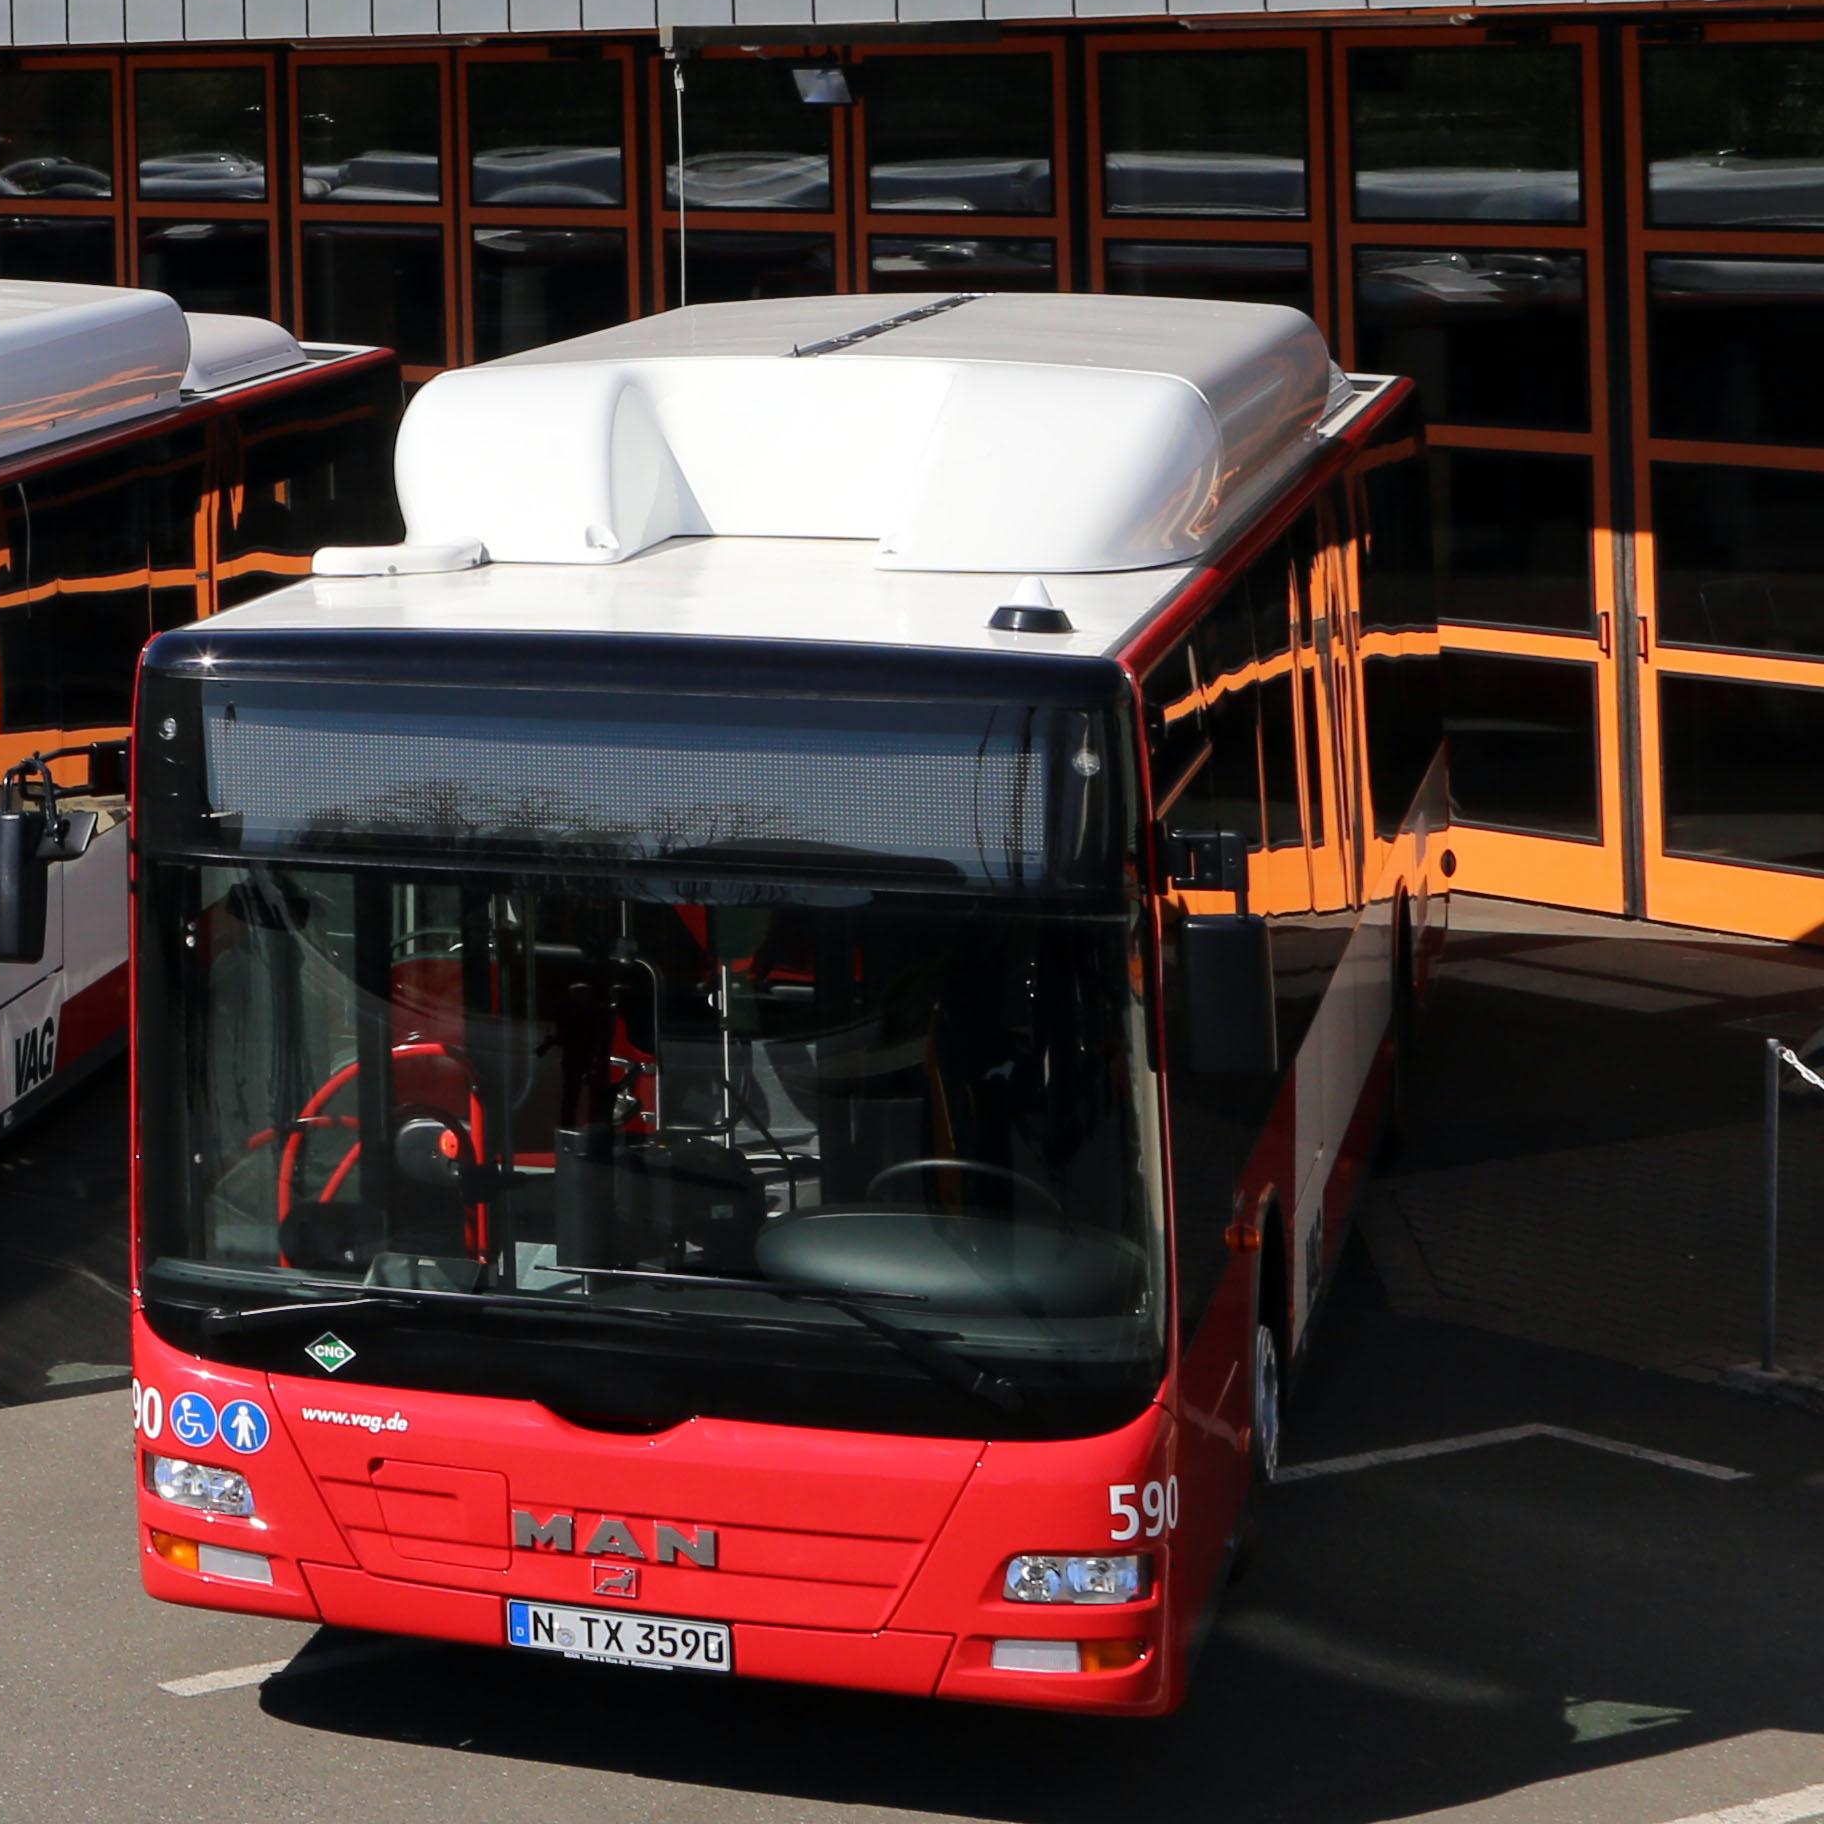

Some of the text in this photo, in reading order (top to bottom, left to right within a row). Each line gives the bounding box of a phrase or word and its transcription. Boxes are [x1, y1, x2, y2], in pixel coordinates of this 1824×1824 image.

[14, 1015, 55, 1099] VAG
[313, 1343, 346, 1359] CNG
[301, 1406, 409, 1433] www.vag.de
[1108, 1474, 1179, 1542] 590
[512, 1509, 718, 1568] MAN
[532, 1610, 554, 1643] N
[579, 1616, 625, 1653] TX
[636, 1622, 725, 1664] 3590
